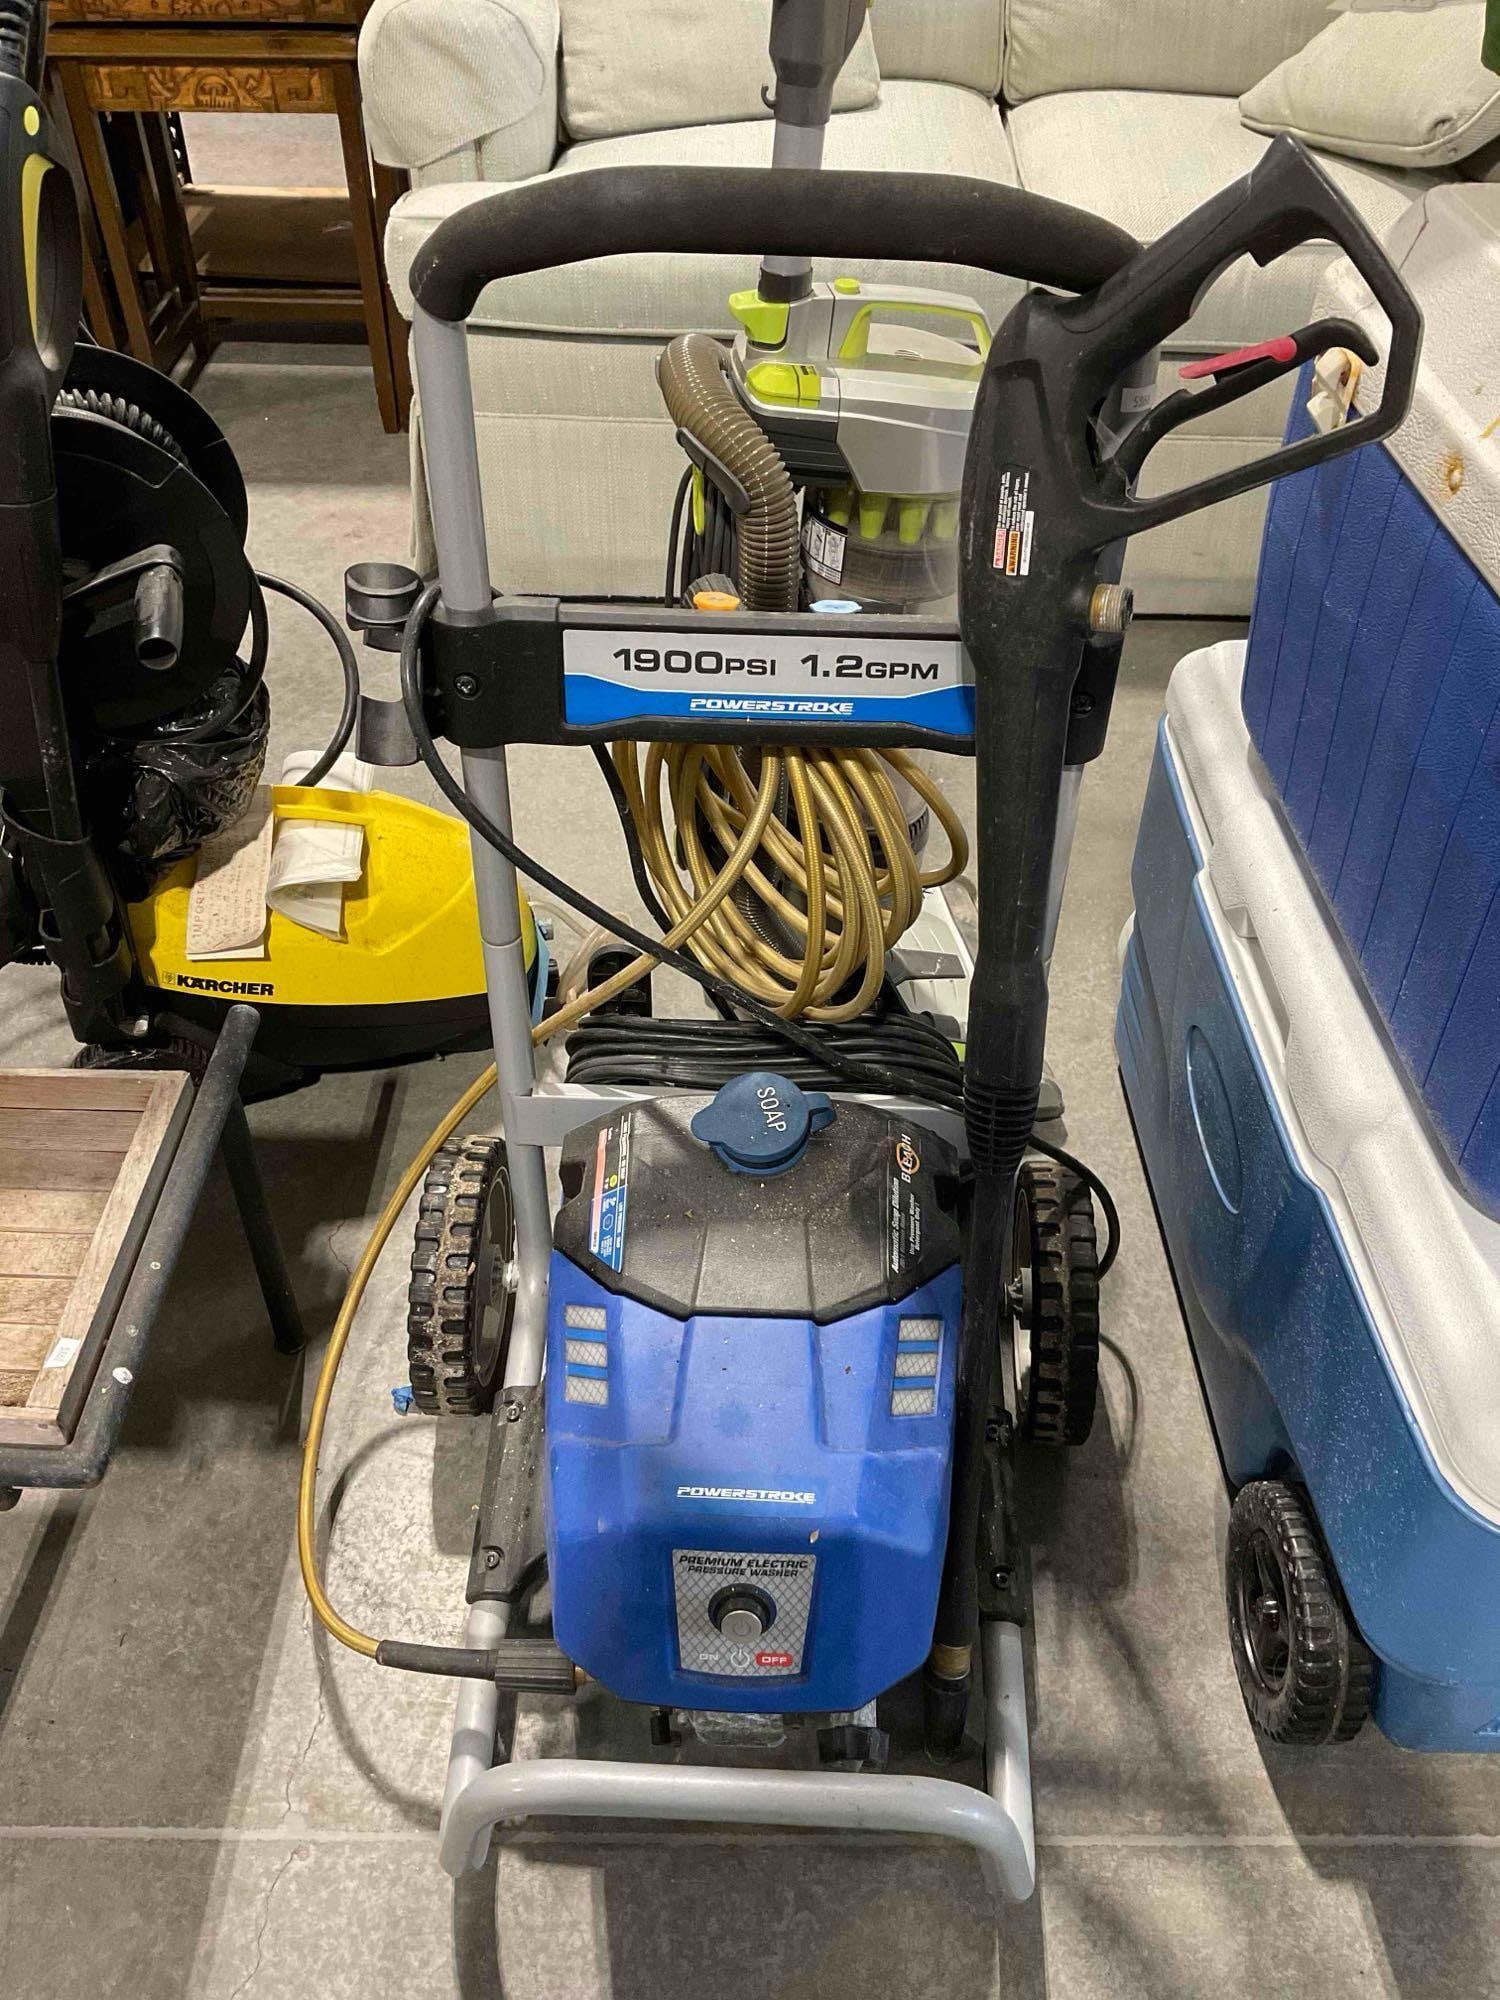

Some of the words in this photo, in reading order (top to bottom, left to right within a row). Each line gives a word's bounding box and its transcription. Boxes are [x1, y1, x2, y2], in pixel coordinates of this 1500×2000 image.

[1009, 534, 1018, 564] WARNING
[612, 648, 776, 676] 1900PSI
[800, 654, 939, 680] 1.2GPM
[690, 698, 854, 715] POWERSTROKE
[756, 1086, 787, 1132] SOAP
[901, 1133, 914, 1183] BLEACH
[891, 1177, 901, 1208] Dilution
[891, 1208, 901, 1230] Soap
[891, 1230, 900, 1274] Automatic
[677, 1486, 817, 1504] POWERSTROKE
[679, 1554, 742, 1568] PREMIUM
[747, 1559, 808, 1570] ELECTRIC
[688, 1565, 746, 1576] PRESSURE
[750, 1569, 798, 1577] WASHER
[699, 1652, 719, 1661] ON
[761, 1655, 788, 1664] OFF
